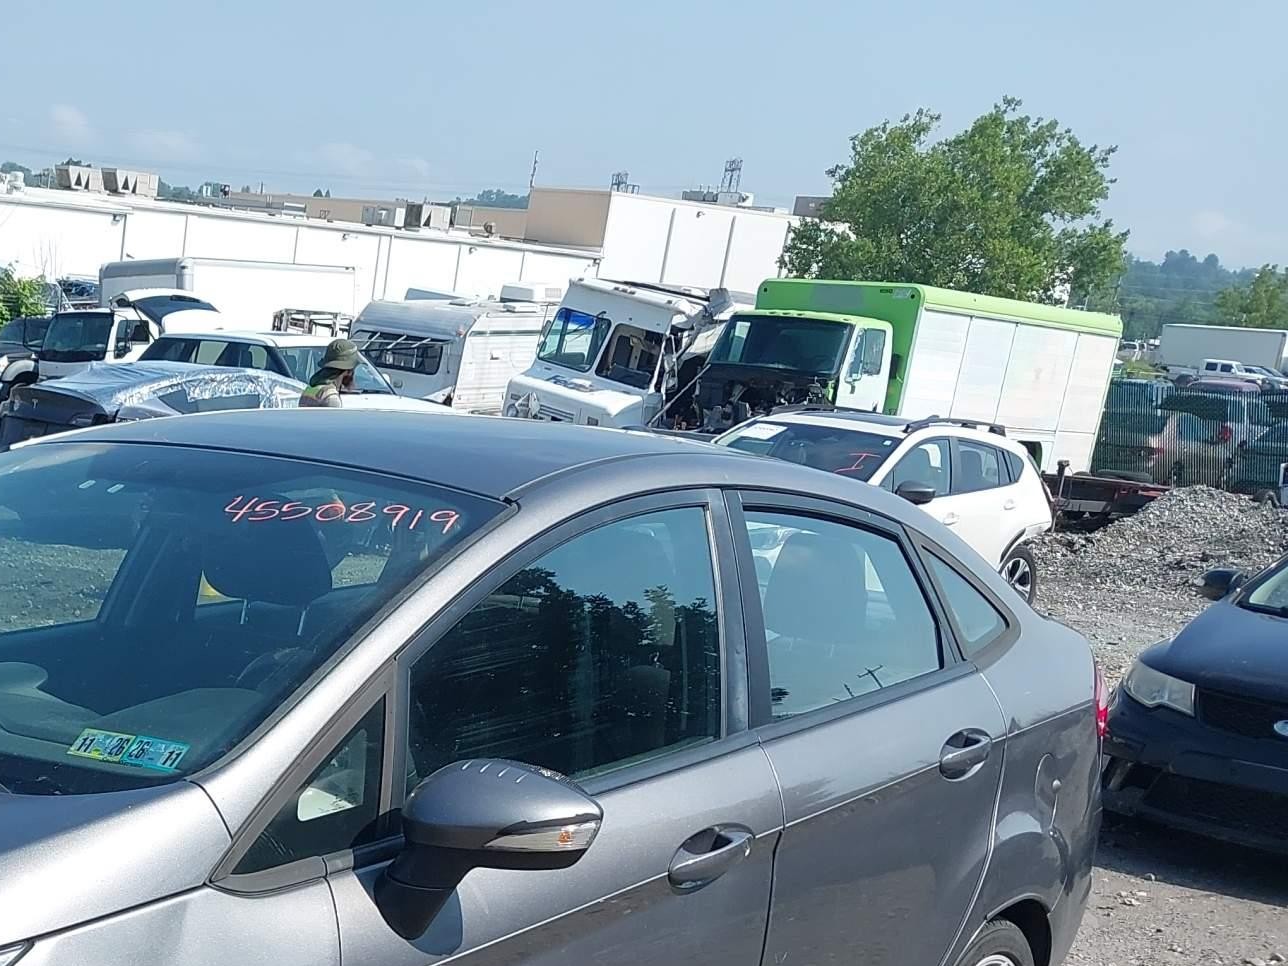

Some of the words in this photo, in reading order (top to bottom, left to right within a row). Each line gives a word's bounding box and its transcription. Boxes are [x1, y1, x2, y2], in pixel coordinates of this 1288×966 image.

[223, 495, 460, 534] 45508919
[76, 736, 96, 754] 11
[108, 737, 130, 757] 26
[128, 739, 151, 760] 26
[161, 750, 183, 768] 11
